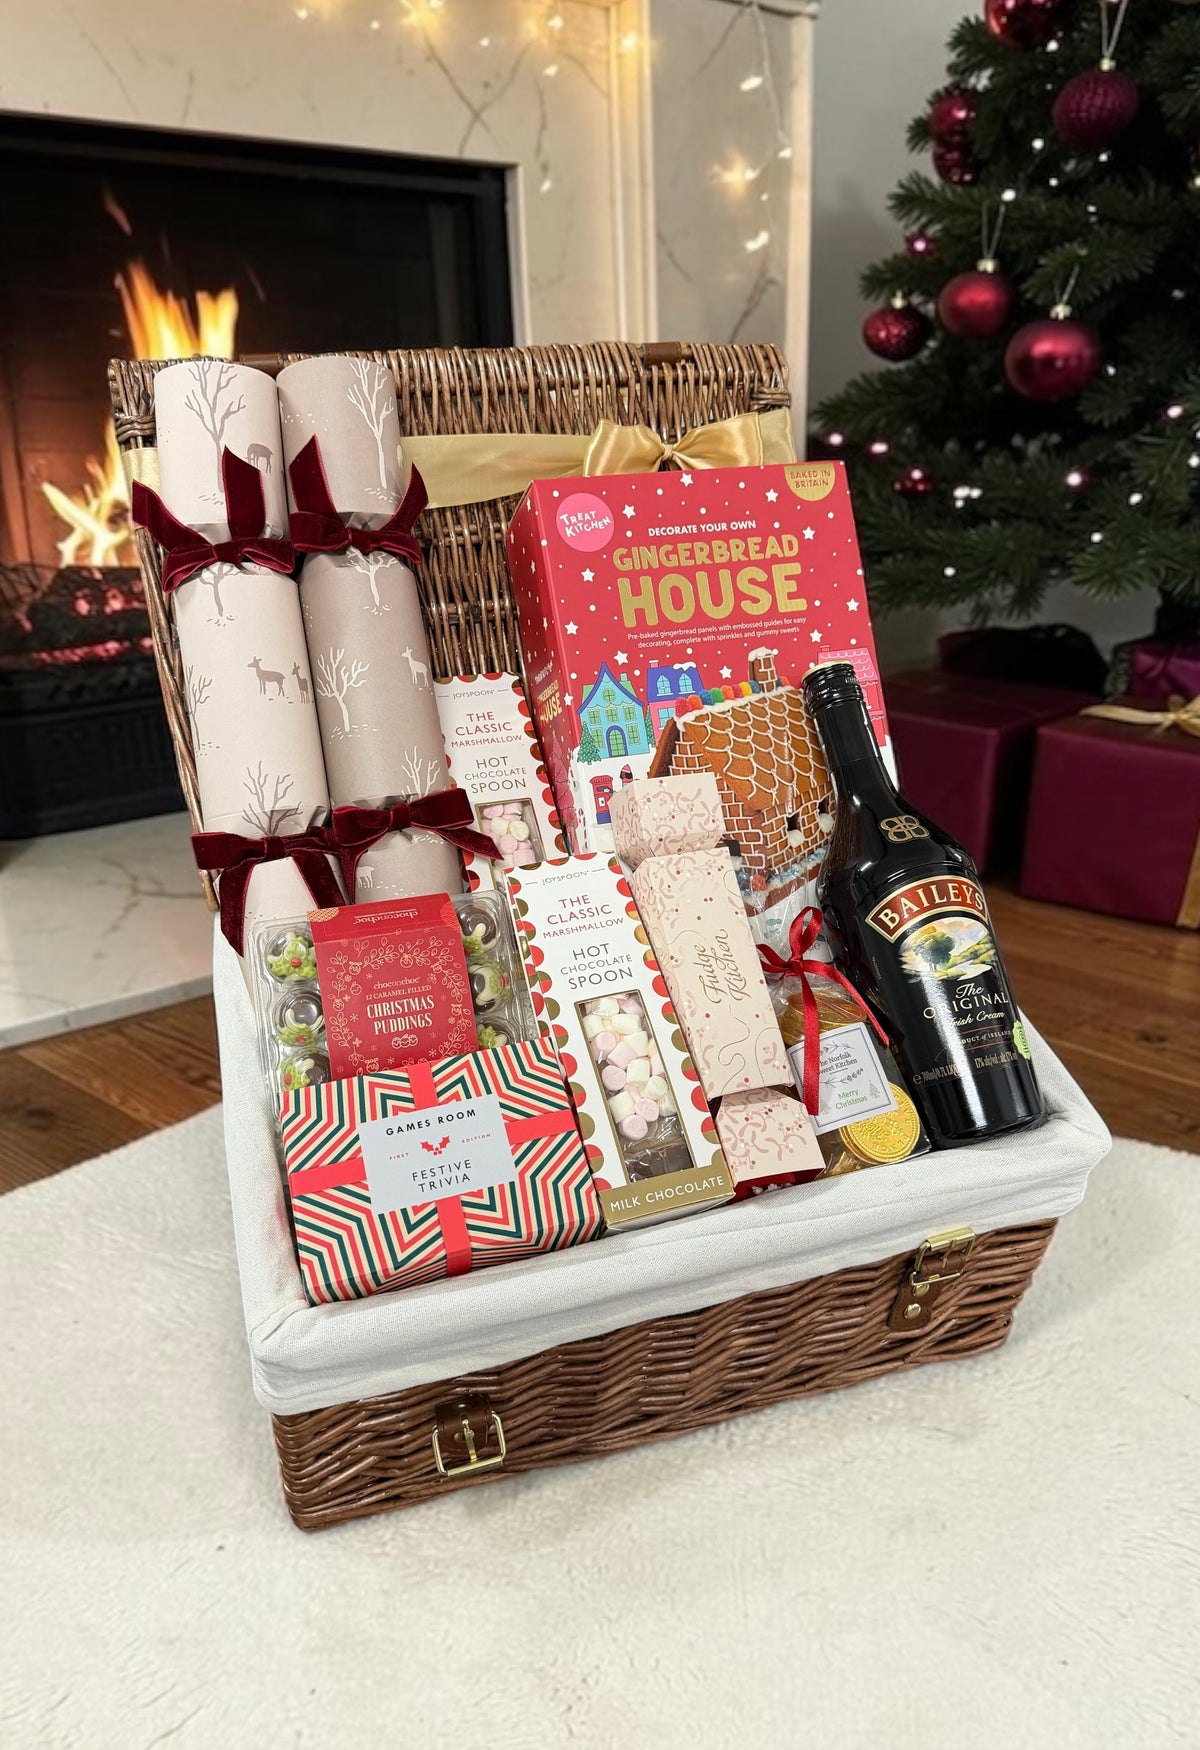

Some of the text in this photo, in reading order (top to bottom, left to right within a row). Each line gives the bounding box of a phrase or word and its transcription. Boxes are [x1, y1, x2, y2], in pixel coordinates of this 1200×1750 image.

[790, 469, 831, 480] BAKED IN
[795, 479, 829, 489] BRITAIN
[559, 510, 597, 526] TREAT
[565, 515, 611, 538] KITCHEN
[648, 519, 757, 537] DECORATE YOUR OWN
[613, 534, 799, 571] GINGERBREAD
[617, 562, 808, 628] HOUSE
[627, 617, 807, 640] Pre-baked gingerbread panels with embossed guides for easy
[637, 640, 673, 648] decorating,
[673, 636, 702, 645] complete
[716, 632, 744, 642] sprinkles
[744, 630, 756, 638] and
[756, 629, 779, 638] gummy
[779, 626, 800, 634] sweets
[453, 690, 494, 700] JOYSPOON
[466, 711, 495, 722] THE
[455, 721, 513, 736] CLASSIC
[451, 735, 522, 748] MARSHMALLOW
[476, 756, 508, 769] HOT
[464, 767, 527, 780] CHOCOLATE
[470, 778, 527, 794] SPOON
[542, 871, 588, 886] JOYSPOON
[558, 894, 591, 909] THE
[877, 882, 984, 930] BAILEYS
[547, 904, 612, 925] CLASSIC
[543, 917, 624, 939] MARSHMALLOW
[572, 943, 610, 961] HOT
[560, 954, 633, 975] CHOCOLATE
[711, 928, 752, 1001] Kitchen
[568, 966, 633, 990] SPOON
[693, 944, 728, 1004] Fudge
[373, 989, 407, 999] CARAMEL
[407, 985, 432, 994] FILLED
[955, 982, 985, 999] The
[366, 994, 435, 1019] CHRISTMAS
[923, 992, 1009, 1019] ORIGINAL
[374, 1012, 433, 1036] PUDDINGS
[976, 1010, 1005, 1022] Cream
[819, 1058, 858, 1074] weet Kitchen
[828, 1051, 852, 1064] Norfolk
[835, 1095, 868, 1110] Christmas
[838, 1089, 859, 1100] Merry
[385, 1109, 476, 1136] GAMES ROOM
[461, 1133, 491, 1144] EDITION
[389, 1152, 410, 1160] FIRST
[412, 1159, 472, 1182] FESTIVE
[418, 1173, 471, 1193] TRIVIA
[610, 1175, 725, 1212] MILK CHOCOLATE
